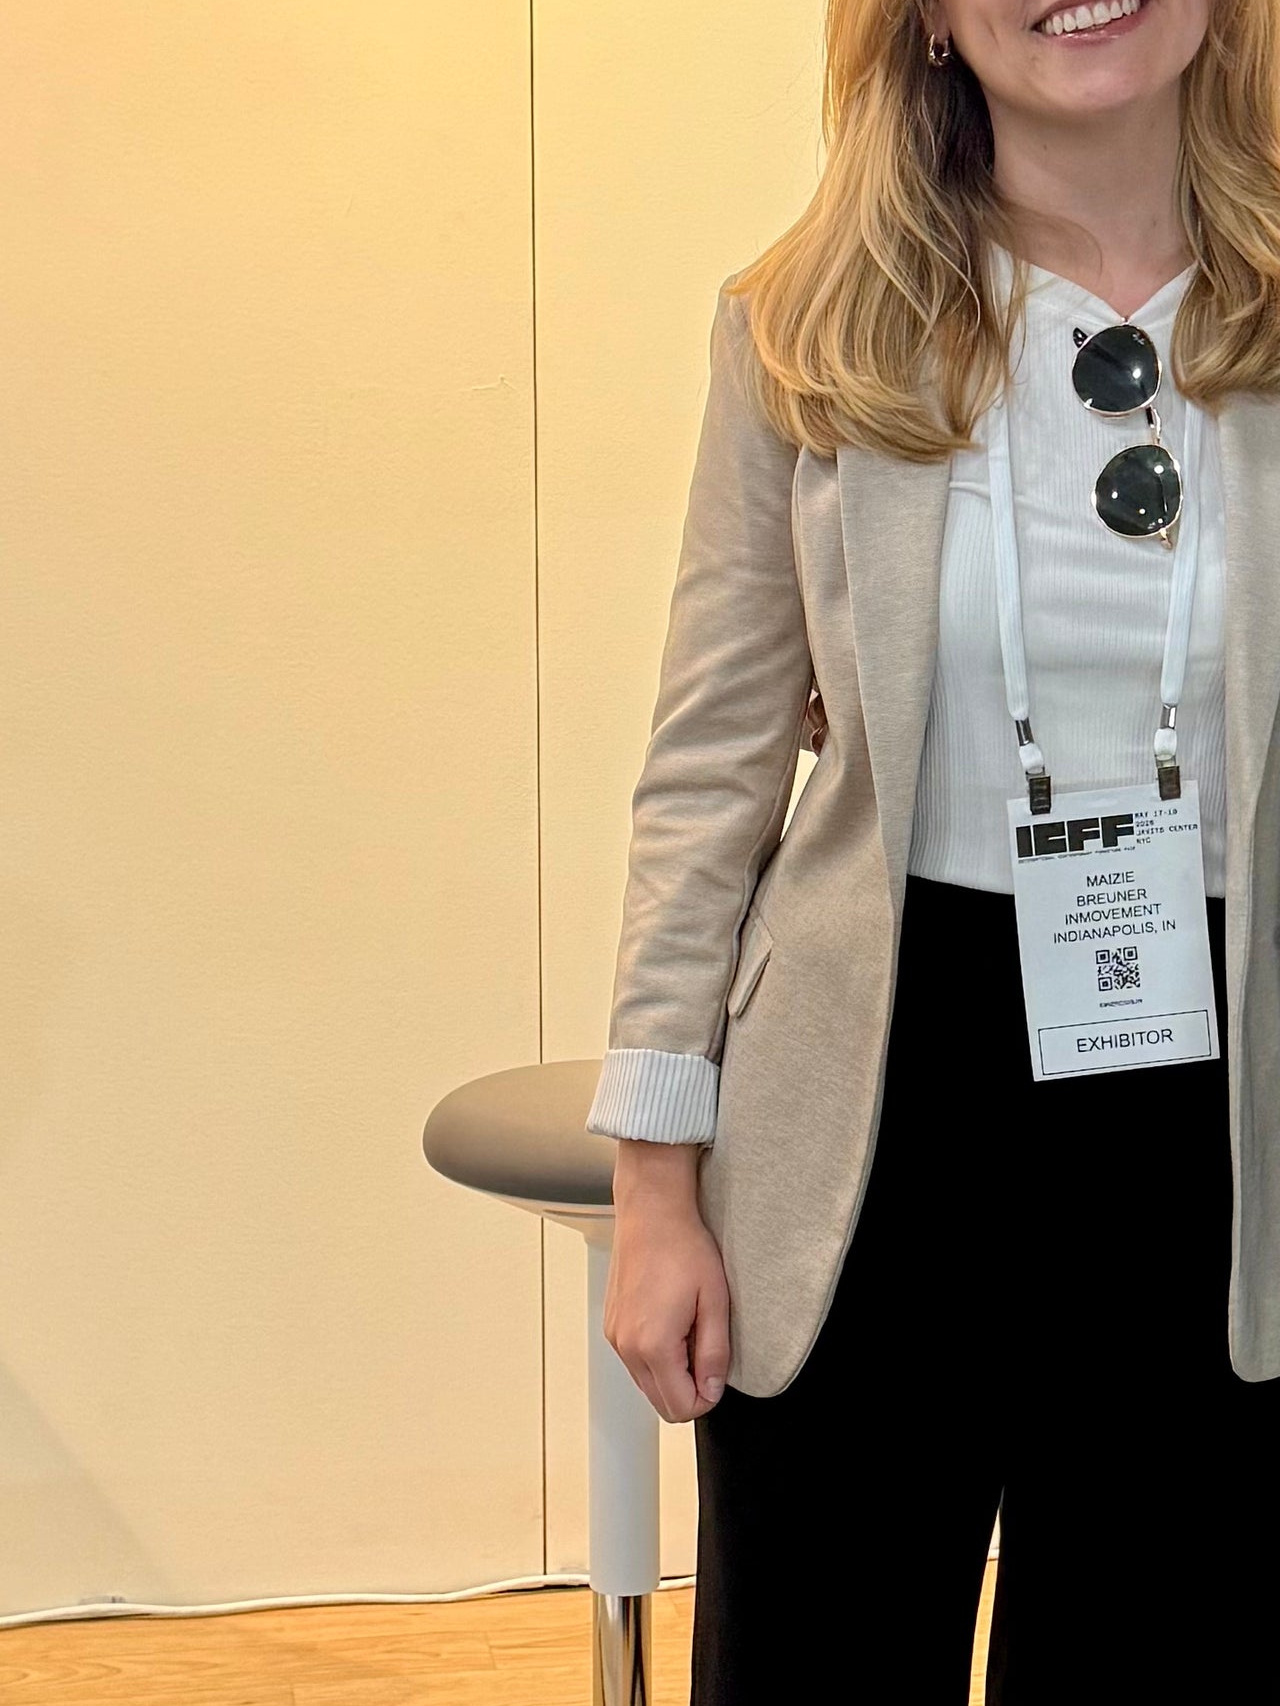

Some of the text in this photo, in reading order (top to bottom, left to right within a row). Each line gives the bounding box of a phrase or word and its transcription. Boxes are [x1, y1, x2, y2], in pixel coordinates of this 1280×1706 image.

[1169, 824, 1198, 832] CENTER
[1086, 871, 1135, 887] MAIZIE
[1076, 888, 1148, 907] BREUNER
[1065, 903, 1162, 925] INMOVEMENT
[1053, 919, 1176, 944] INDIANAPOLIS, IN
[1076, 1028, 1174, 1053] EXHIBITOR
